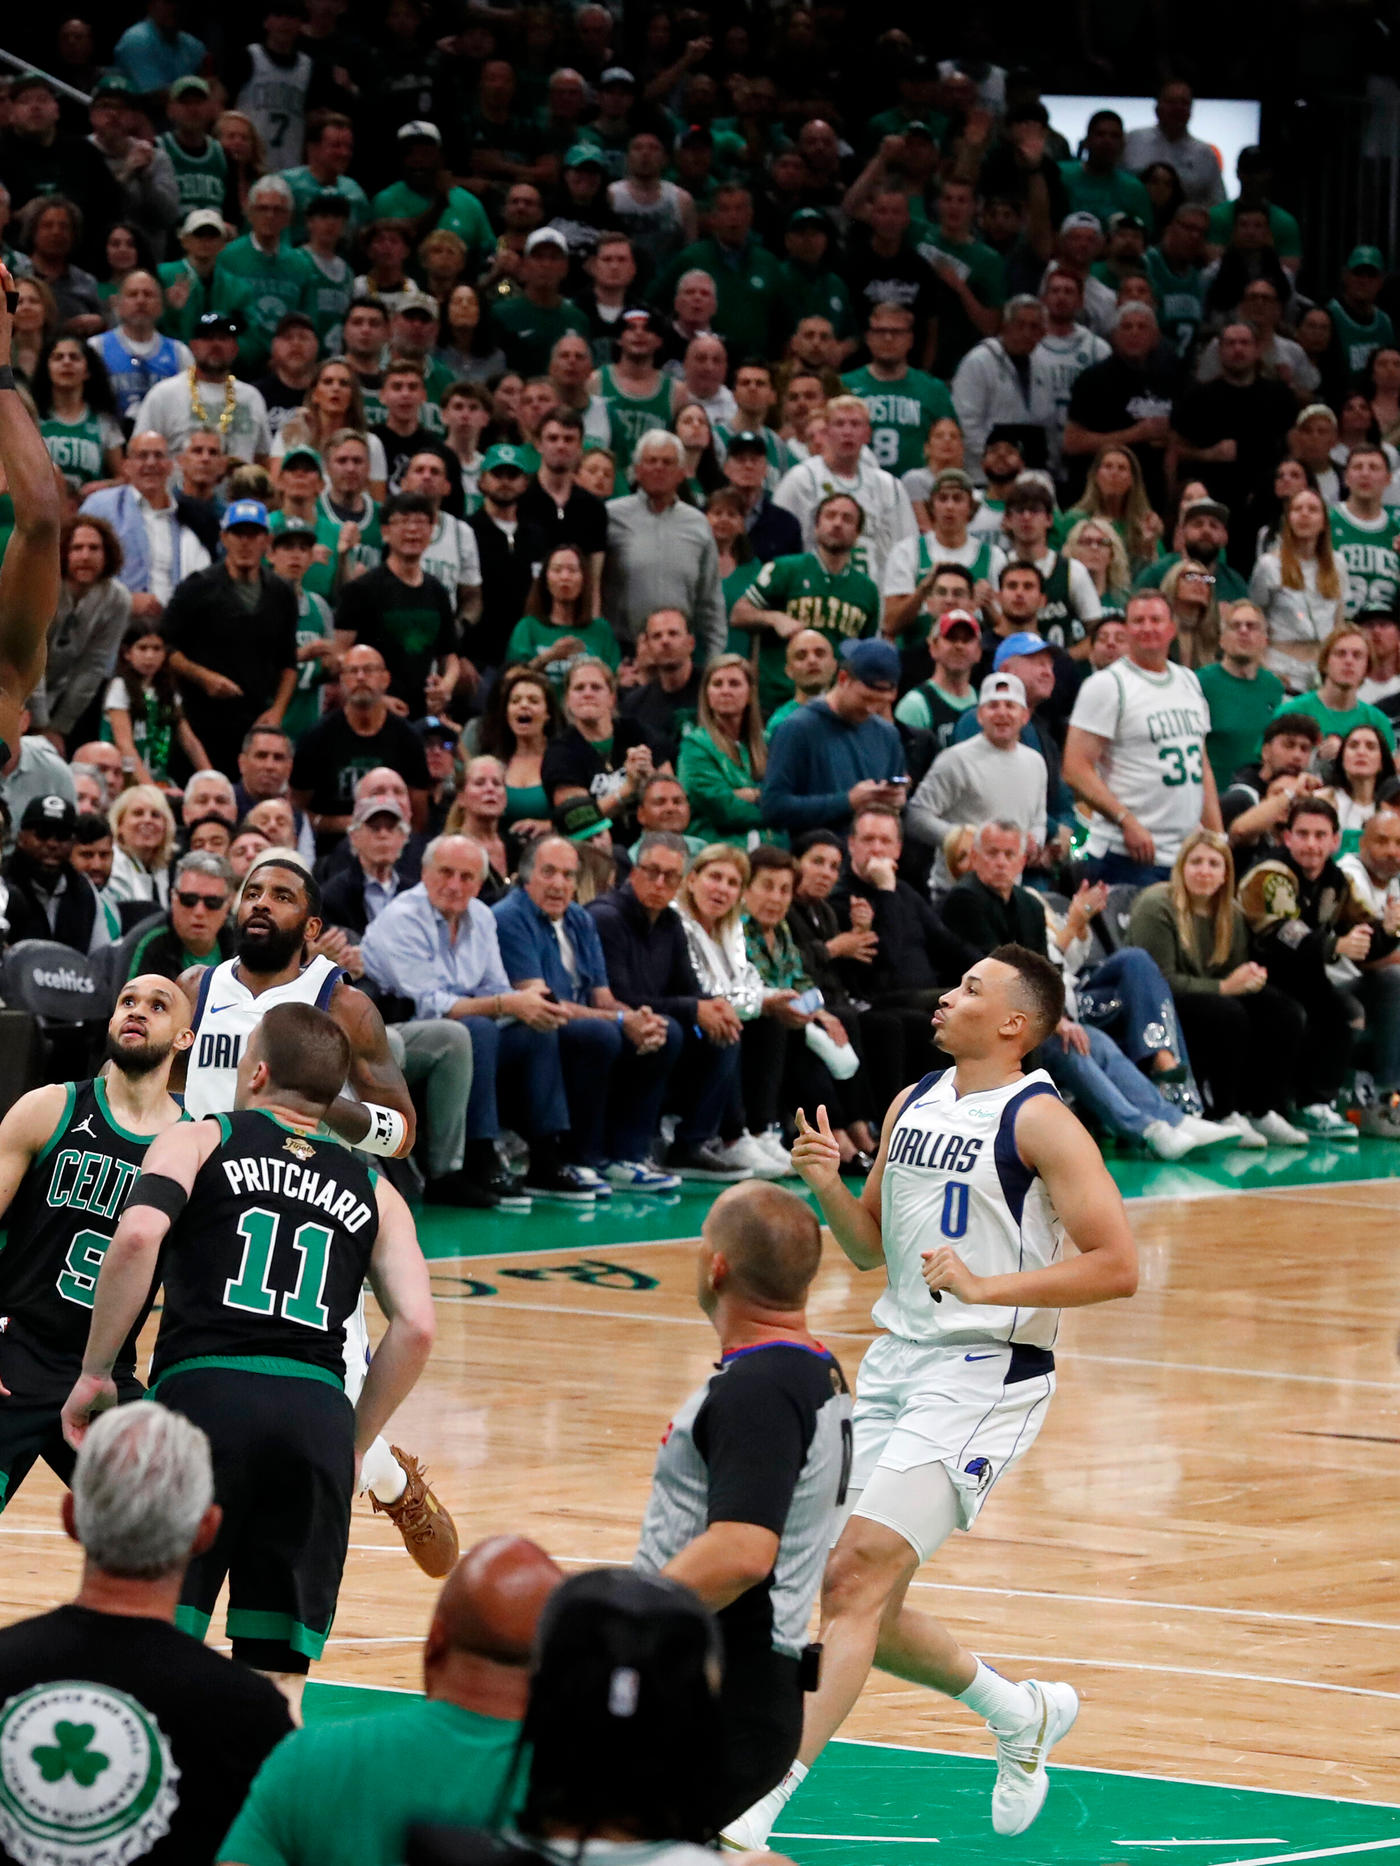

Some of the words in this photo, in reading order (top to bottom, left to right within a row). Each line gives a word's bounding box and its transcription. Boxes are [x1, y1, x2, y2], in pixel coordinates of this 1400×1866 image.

[268, 112, 290, 147] 7
[871, 428, 900, 467] 8
[1146, 708, 1206, 745] CELTICS
[1158, 744, 1204, 788] 33
[887, 1126, 983, 1174] DALLAS
[222, 1156, 372, 1234] PRITCHARD
[940, 1180, 969, 1240] 0
[56, 1228, 113, 1309] 9
[222, 1206, 335, 1332] 11
